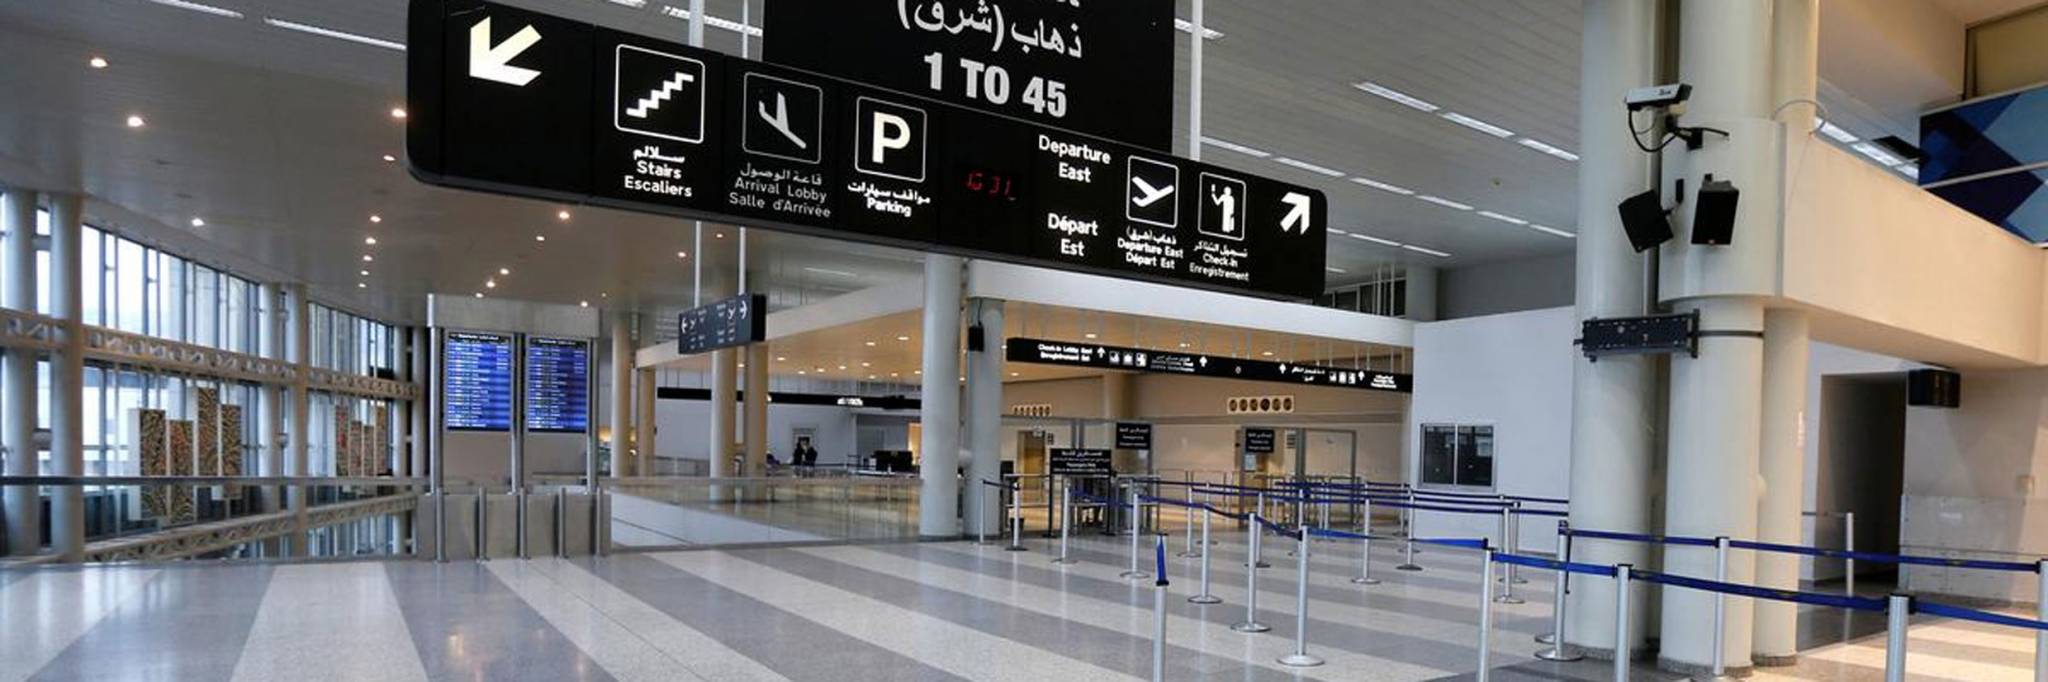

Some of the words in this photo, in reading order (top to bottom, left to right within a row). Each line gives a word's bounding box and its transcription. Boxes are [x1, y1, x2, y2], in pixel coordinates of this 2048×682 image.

[1011, 19, 1082, 58] ذهاب
[924, 52, 943, 91] 1
[960, 58, 1010, 105] TO
[1022, 76, 1067, 118] 45
[872, 111, 911, 164] P
[1038, 134, 1111, 165] Departure
[636, 160, 682, 179] Stairs
[740, 161, 791, 181] الوصول
[1058, 161, 1091, 183] East
[624, 175, 692, 197] Escaliers
[734, 177, 780, 195] Arrival
[787, 185, 827, 204] Lobby
[729, 192, 765, 209] Salle
[867, 197, 912, 218] Parking
[1047, 212, 1098, 236] Départ
[1060, 238, 1085, 257] Est
[1117, 237, 1162, 255] Departure
[1164, 246, 1184, 258] East
[1125, 251, 1158, 267] Départ
[1160, 257, 1176, 269] Est
[1189, 262, 1250, 282] Enregistrement
